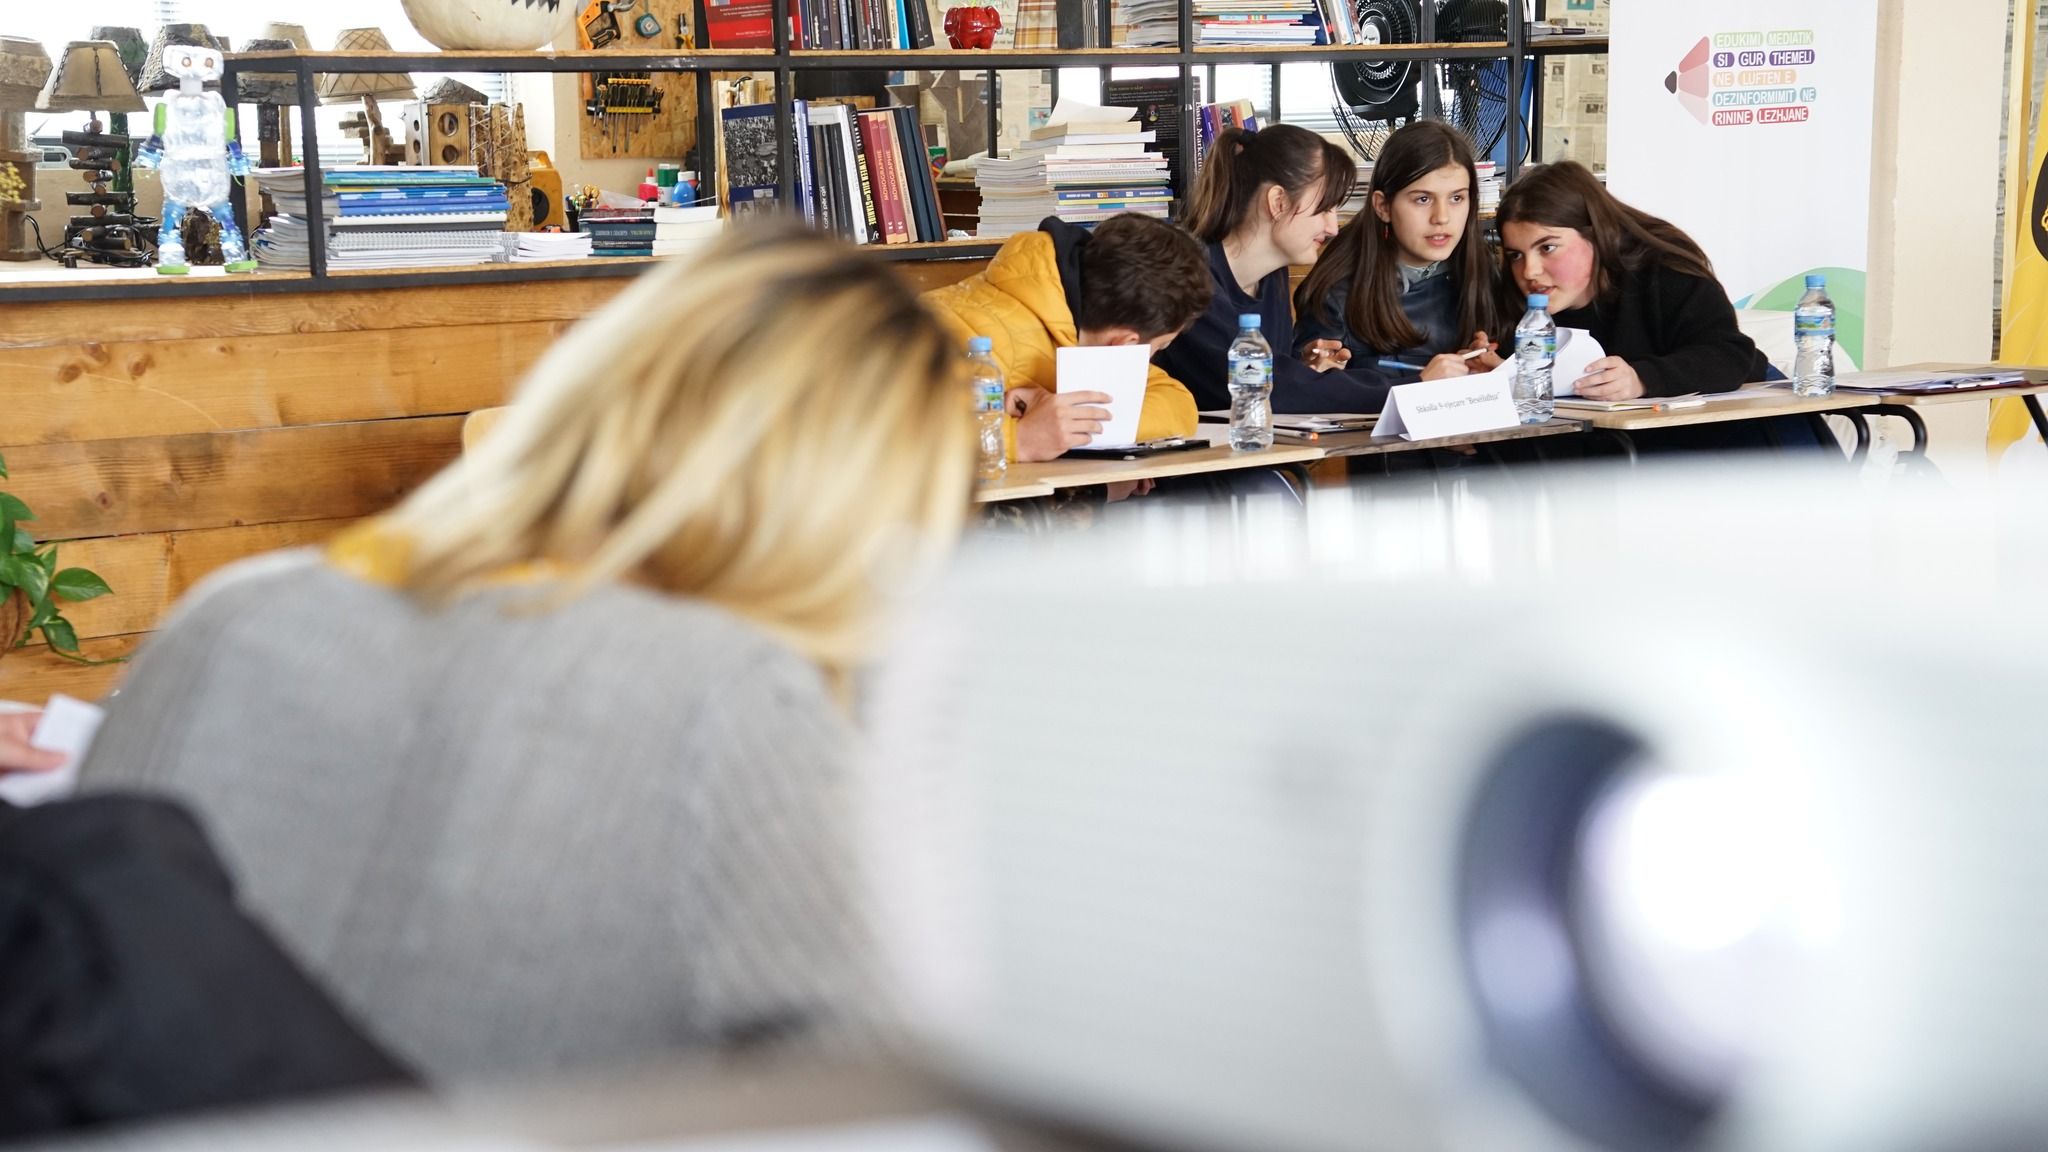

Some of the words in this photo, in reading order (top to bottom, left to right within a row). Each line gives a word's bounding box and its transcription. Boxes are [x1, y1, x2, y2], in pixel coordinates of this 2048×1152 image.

[1716, 33, 1761, 47] EDUKIMI
[1768, 31, 1812, 45] MEDIATIK
[1717, 54, 1728, 67] SI
[1740, 52, 1764, 66] GUR
[1772, 51, 1813, 65] THEMELI
[1716, 72, 1731, 86] NE
[1743, 71, 1780, 85] LUFTEN
[1715, 90, 1795, 106] DEZINFORMIMIT
[1802, 89, 1815, 102] NE
[1715, 111, 1751, 125] RININE
[1758, 108, 1808, 123] LEZHJANE
[857, 153, 869, 181] BETWEEN
[877, 150, 889, 200] MONOGRAPHIE
[886, 150, 899, 200] MONOGRAPHIE
